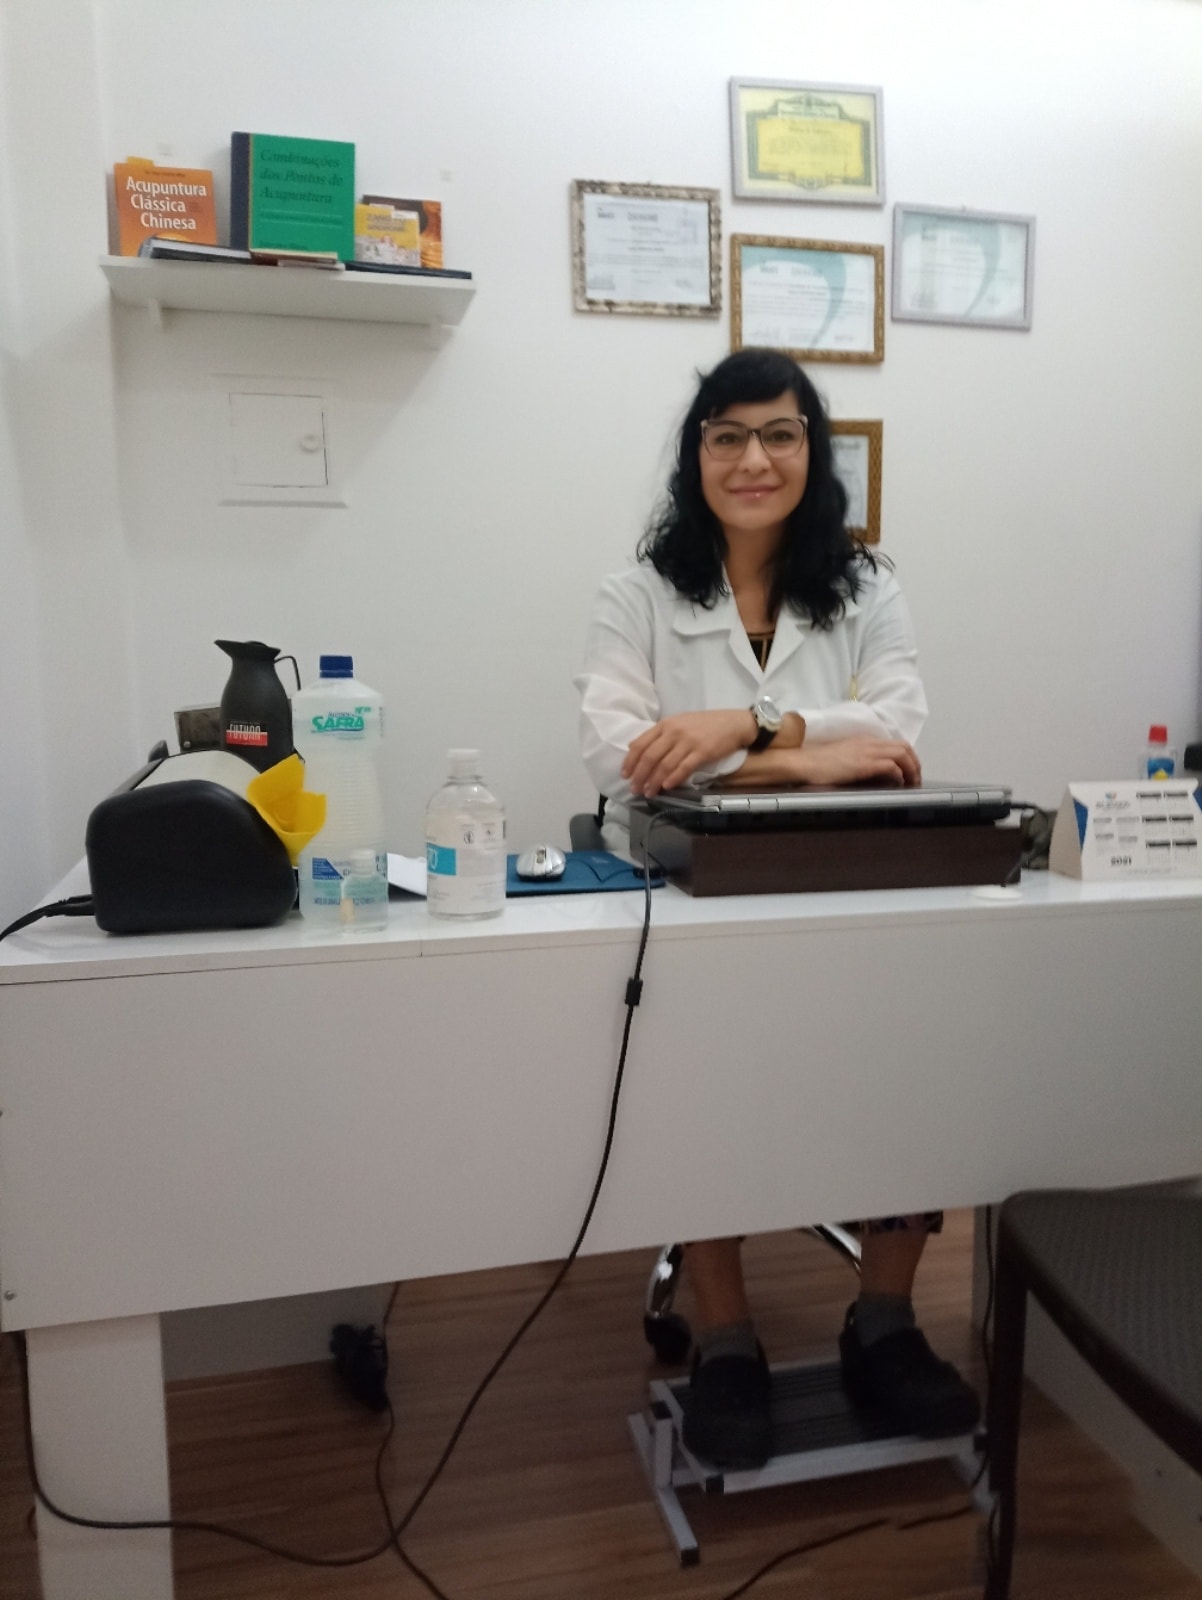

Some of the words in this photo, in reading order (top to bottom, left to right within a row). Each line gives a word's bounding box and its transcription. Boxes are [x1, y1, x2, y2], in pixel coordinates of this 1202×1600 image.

[126, 175, 207, 198] Acupuntura
[130, 193, 187, 213] Clássica
[140, 211, 197, 230] Chinesa
[311, 715, 365, 733] SAFRA
